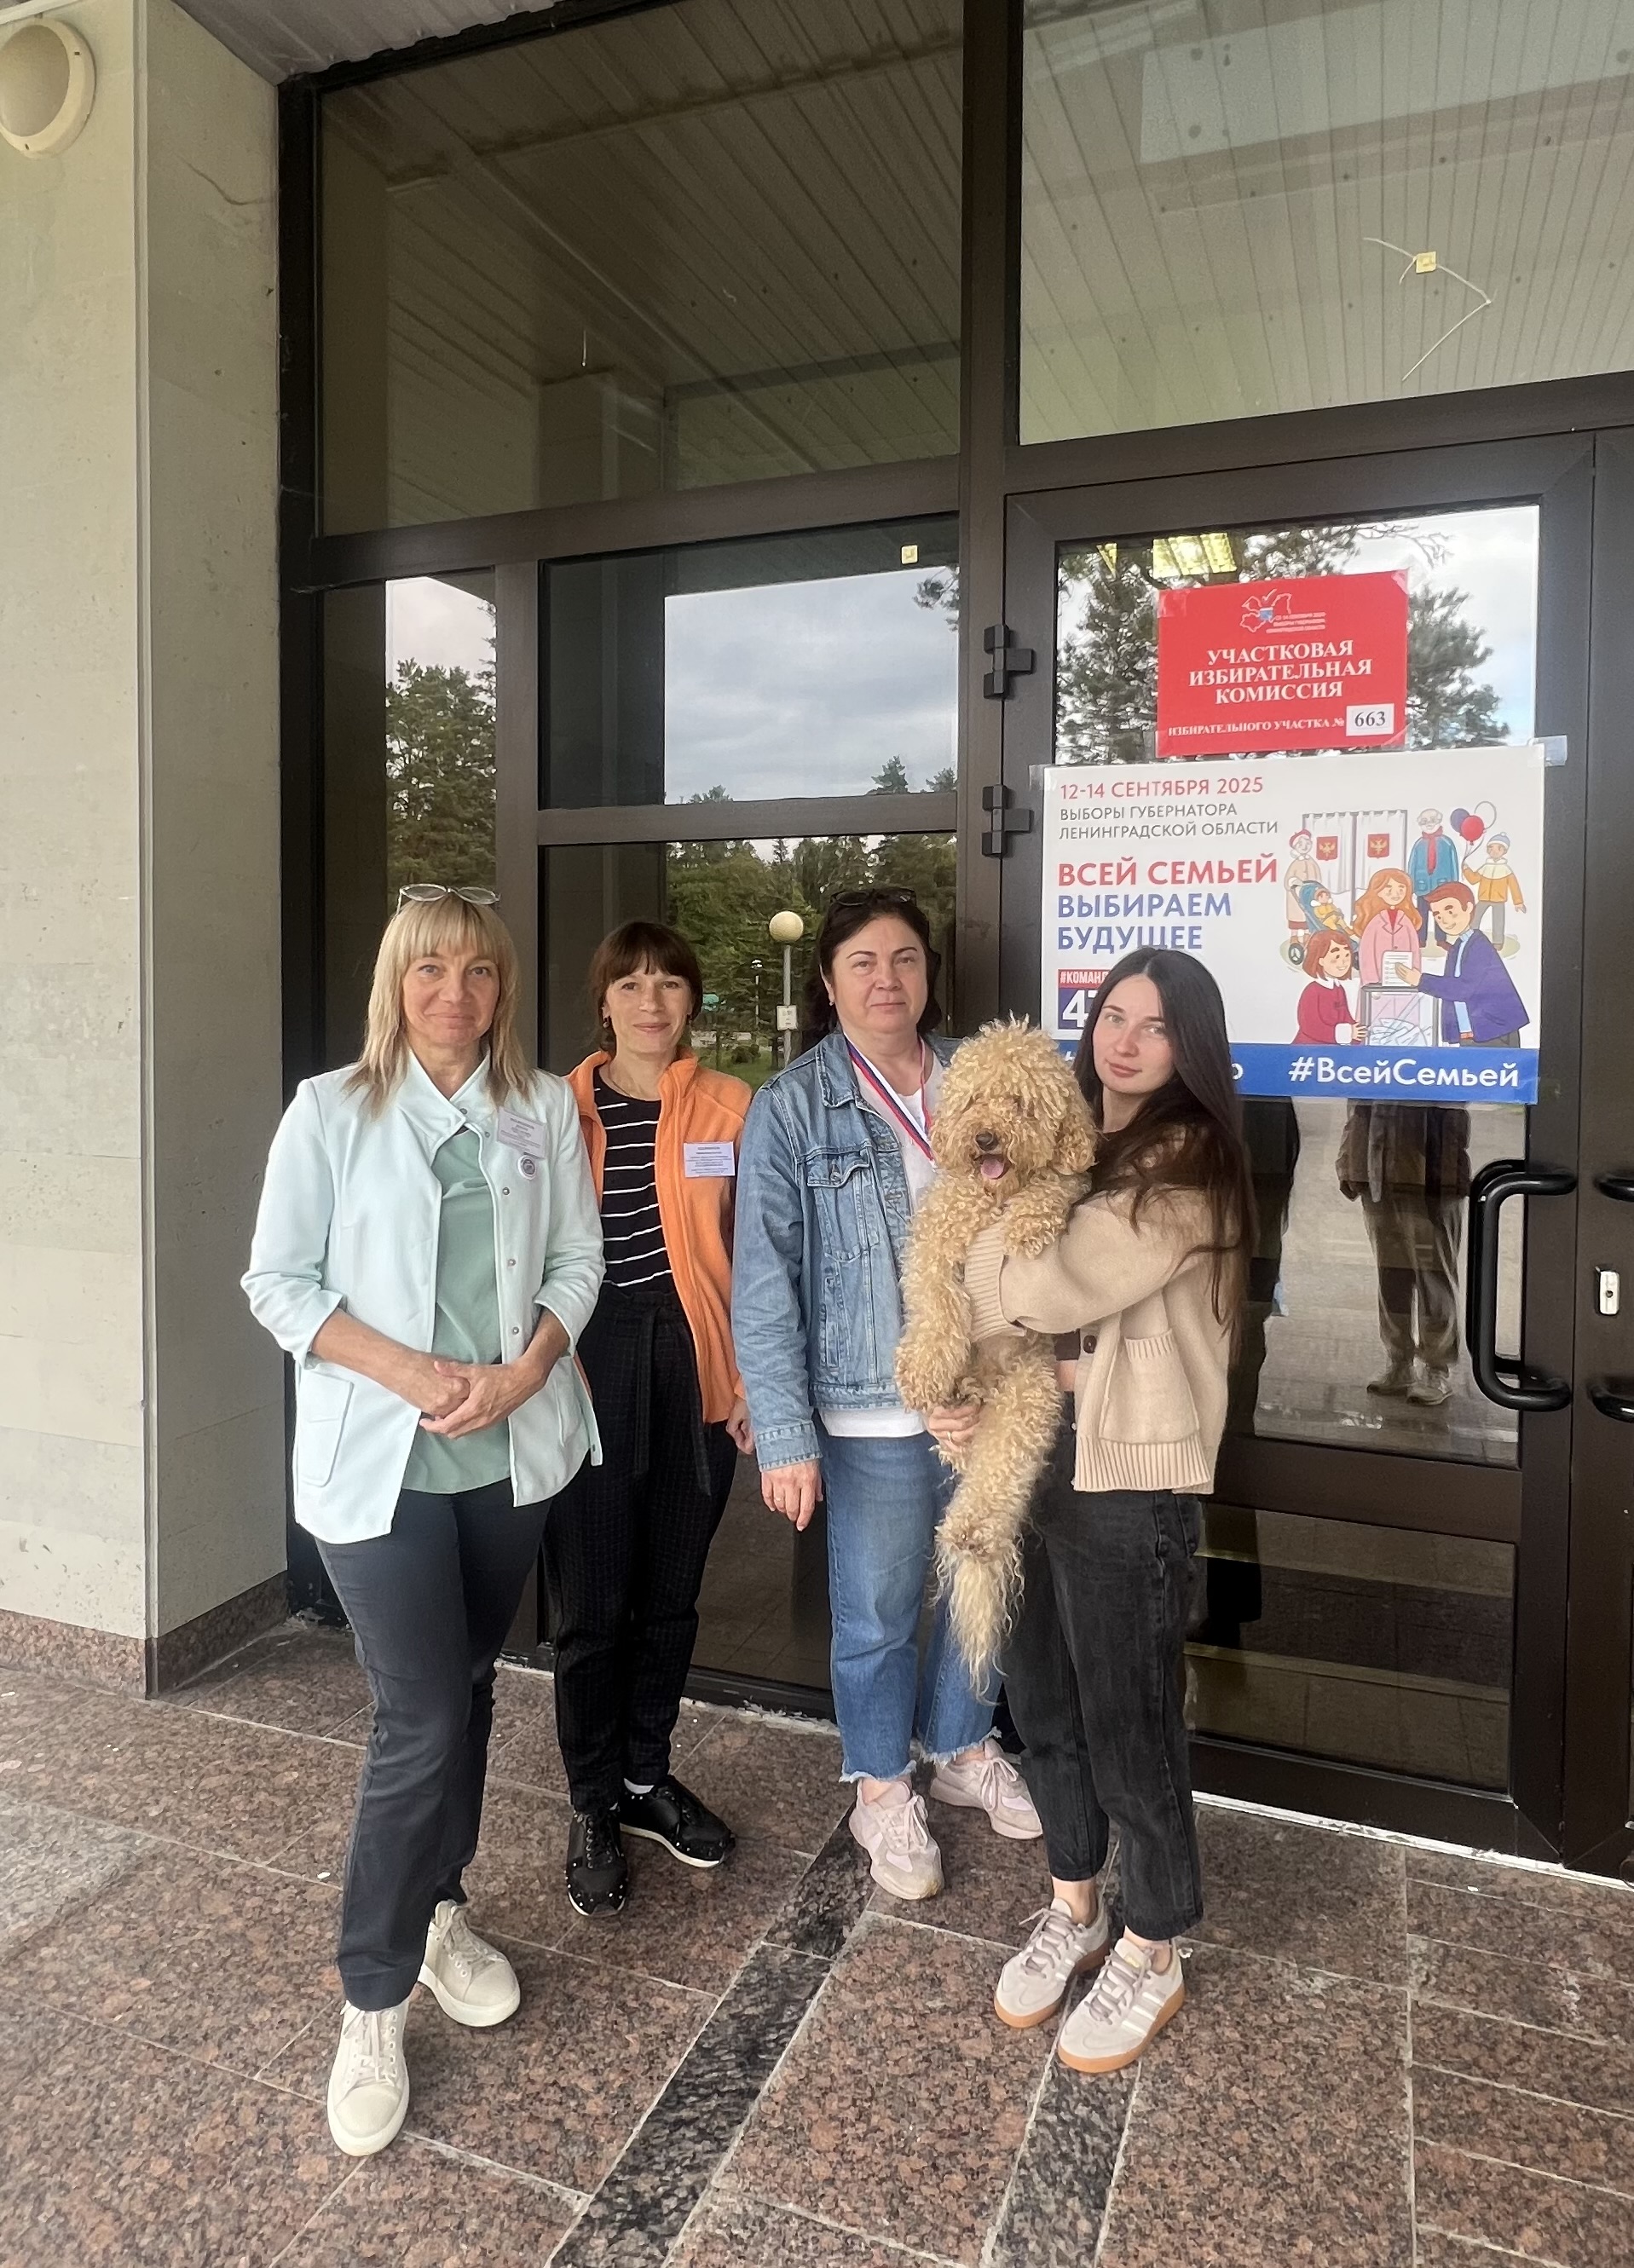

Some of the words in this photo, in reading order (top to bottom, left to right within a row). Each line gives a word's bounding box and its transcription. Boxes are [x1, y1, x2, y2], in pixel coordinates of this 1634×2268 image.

[1206, 639, 1354, 667] УЧАСТКОВАЯ
[1188, 658, 1373, 688] ИЗБИРАТЕЛЬНАЯ
[1215, 681, 1343, 705] КОМИССИЯ
[1168, 722, 1272, 736] ИЗБИРАТЕЛЬНОГО
[1273, 718, 1330, 730] УЧАСТКА
[1354, 711, 1386, 727] 663
[1060, 782, 1106, 799] 12-14
[1111, 778, 1210, 798] СЕНТЯБРЯ
[1216, 776, 1263, 794] 2025
[1060, 807, 1125, 821] ВЫБОРЫ
[1130, 803, 1238, 819] ГУБЕРНАТОРА
[1059, 821, 1197, 840] ЛЕНИНГРАДСКОЙ
[1201, 821, 1279, 836] ОБЛАСТИ
[1058, 856, 1137, 886] ВСЕЙ
[1147, 852, 1278, 886] СЕМЬЕЙ
[1057, 892, 1232, 919] ВЫБИРАЕМ
[1057, 926, 1203, 955] БУДУЩЕЕ
[1288, 1055, 1520, 1088] #ВсейСемьей
